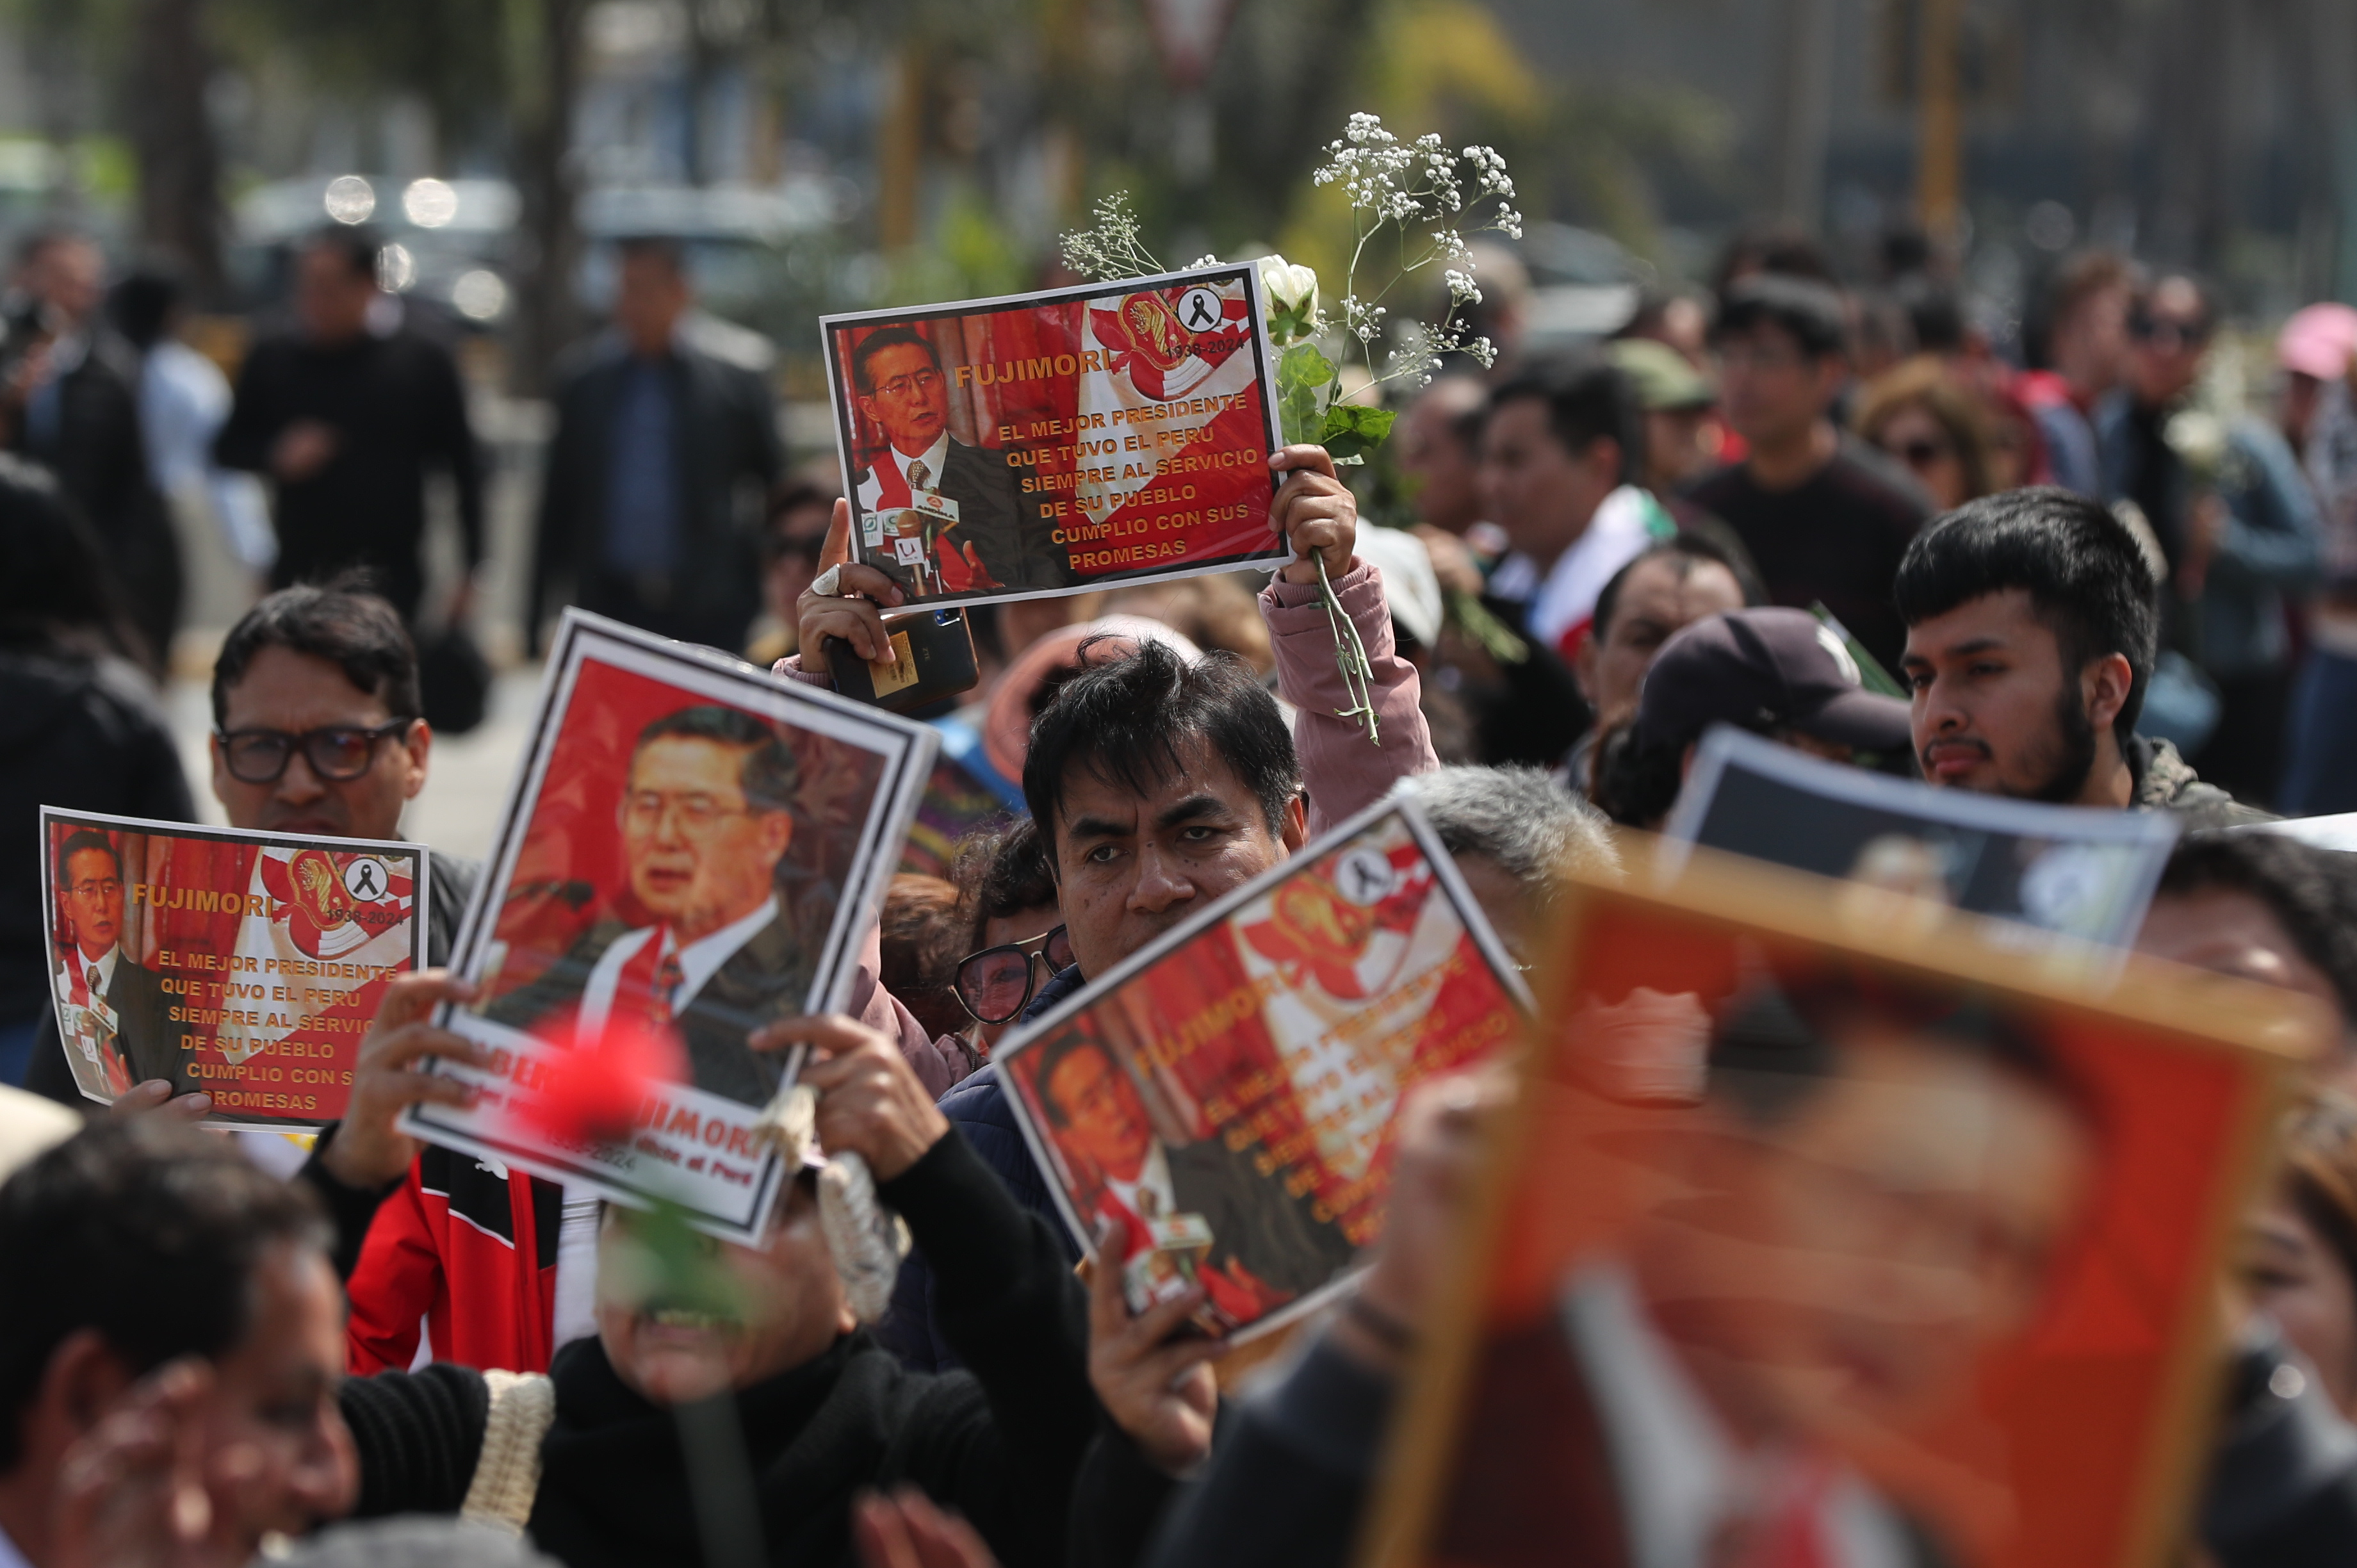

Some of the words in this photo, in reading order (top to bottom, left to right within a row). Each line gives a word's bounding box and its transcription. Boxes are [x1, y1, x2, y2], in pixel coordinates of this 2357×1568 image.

[1165, 337, 1244, 359] 1938-2024
[955, 348, 1111, 388] FUJIMORI
[998, 425, 1025, 441] EL
[1031, 413, 1106, 437] MEJOR
[1112, 392, 1247, 426] PRESIDENTE
[1006, 448, 1052, 467] QUE
[1057, 439, 1117, 461] TUVO
[1124, 434, 1151, 452] EL
[1157, 426, 1214, 448] PERU
[1021, 466, 1116, 493] SIEMPRE
[1123, 462, 1150, 480] AL
[1156, 448, 1257, 476] SERVICIO
[1040, 501, 1068, 518] DE
[1075, 495, 1103, 514] SU
[1110, 484, 1196, 509] PUEBLO
[1052, 518, 1148, 544] CUMPLIO
[1156, 510, 1201, 530] CON
[1207, 503, 1248, 523] SUS
[1069, 540, 1186, 569] PROMESAS
[133, 883, 273, 918] FUJIMORI
[327, 909, 404, 926] 1938-2024
[159, 950, 181, 967] EL
[188, 952, 258, 973] MEJOR
[265, 958, 397, 982] PRESIDENTE
[161, 977, 201, 996] QUE
[208, 982, 265, 1000] TUVO
[272, 986, 297, 1002] EL
[304, 988, 361, 1007] PERU
[168, 1006, 259, 1027] SIEMPRE
[265, 1013, 292, 1029] AL
[298, 1014, 375, 1033] SERVIC
[181, 1034, 207, 1050] DE
[214, 1036, 241, 1052] SU
[250, 1038, 334, 1058] PUEBLO
[186, 1062, 283, 1082] CUMPLIO
[290, 1067, 335, 1084] CON
